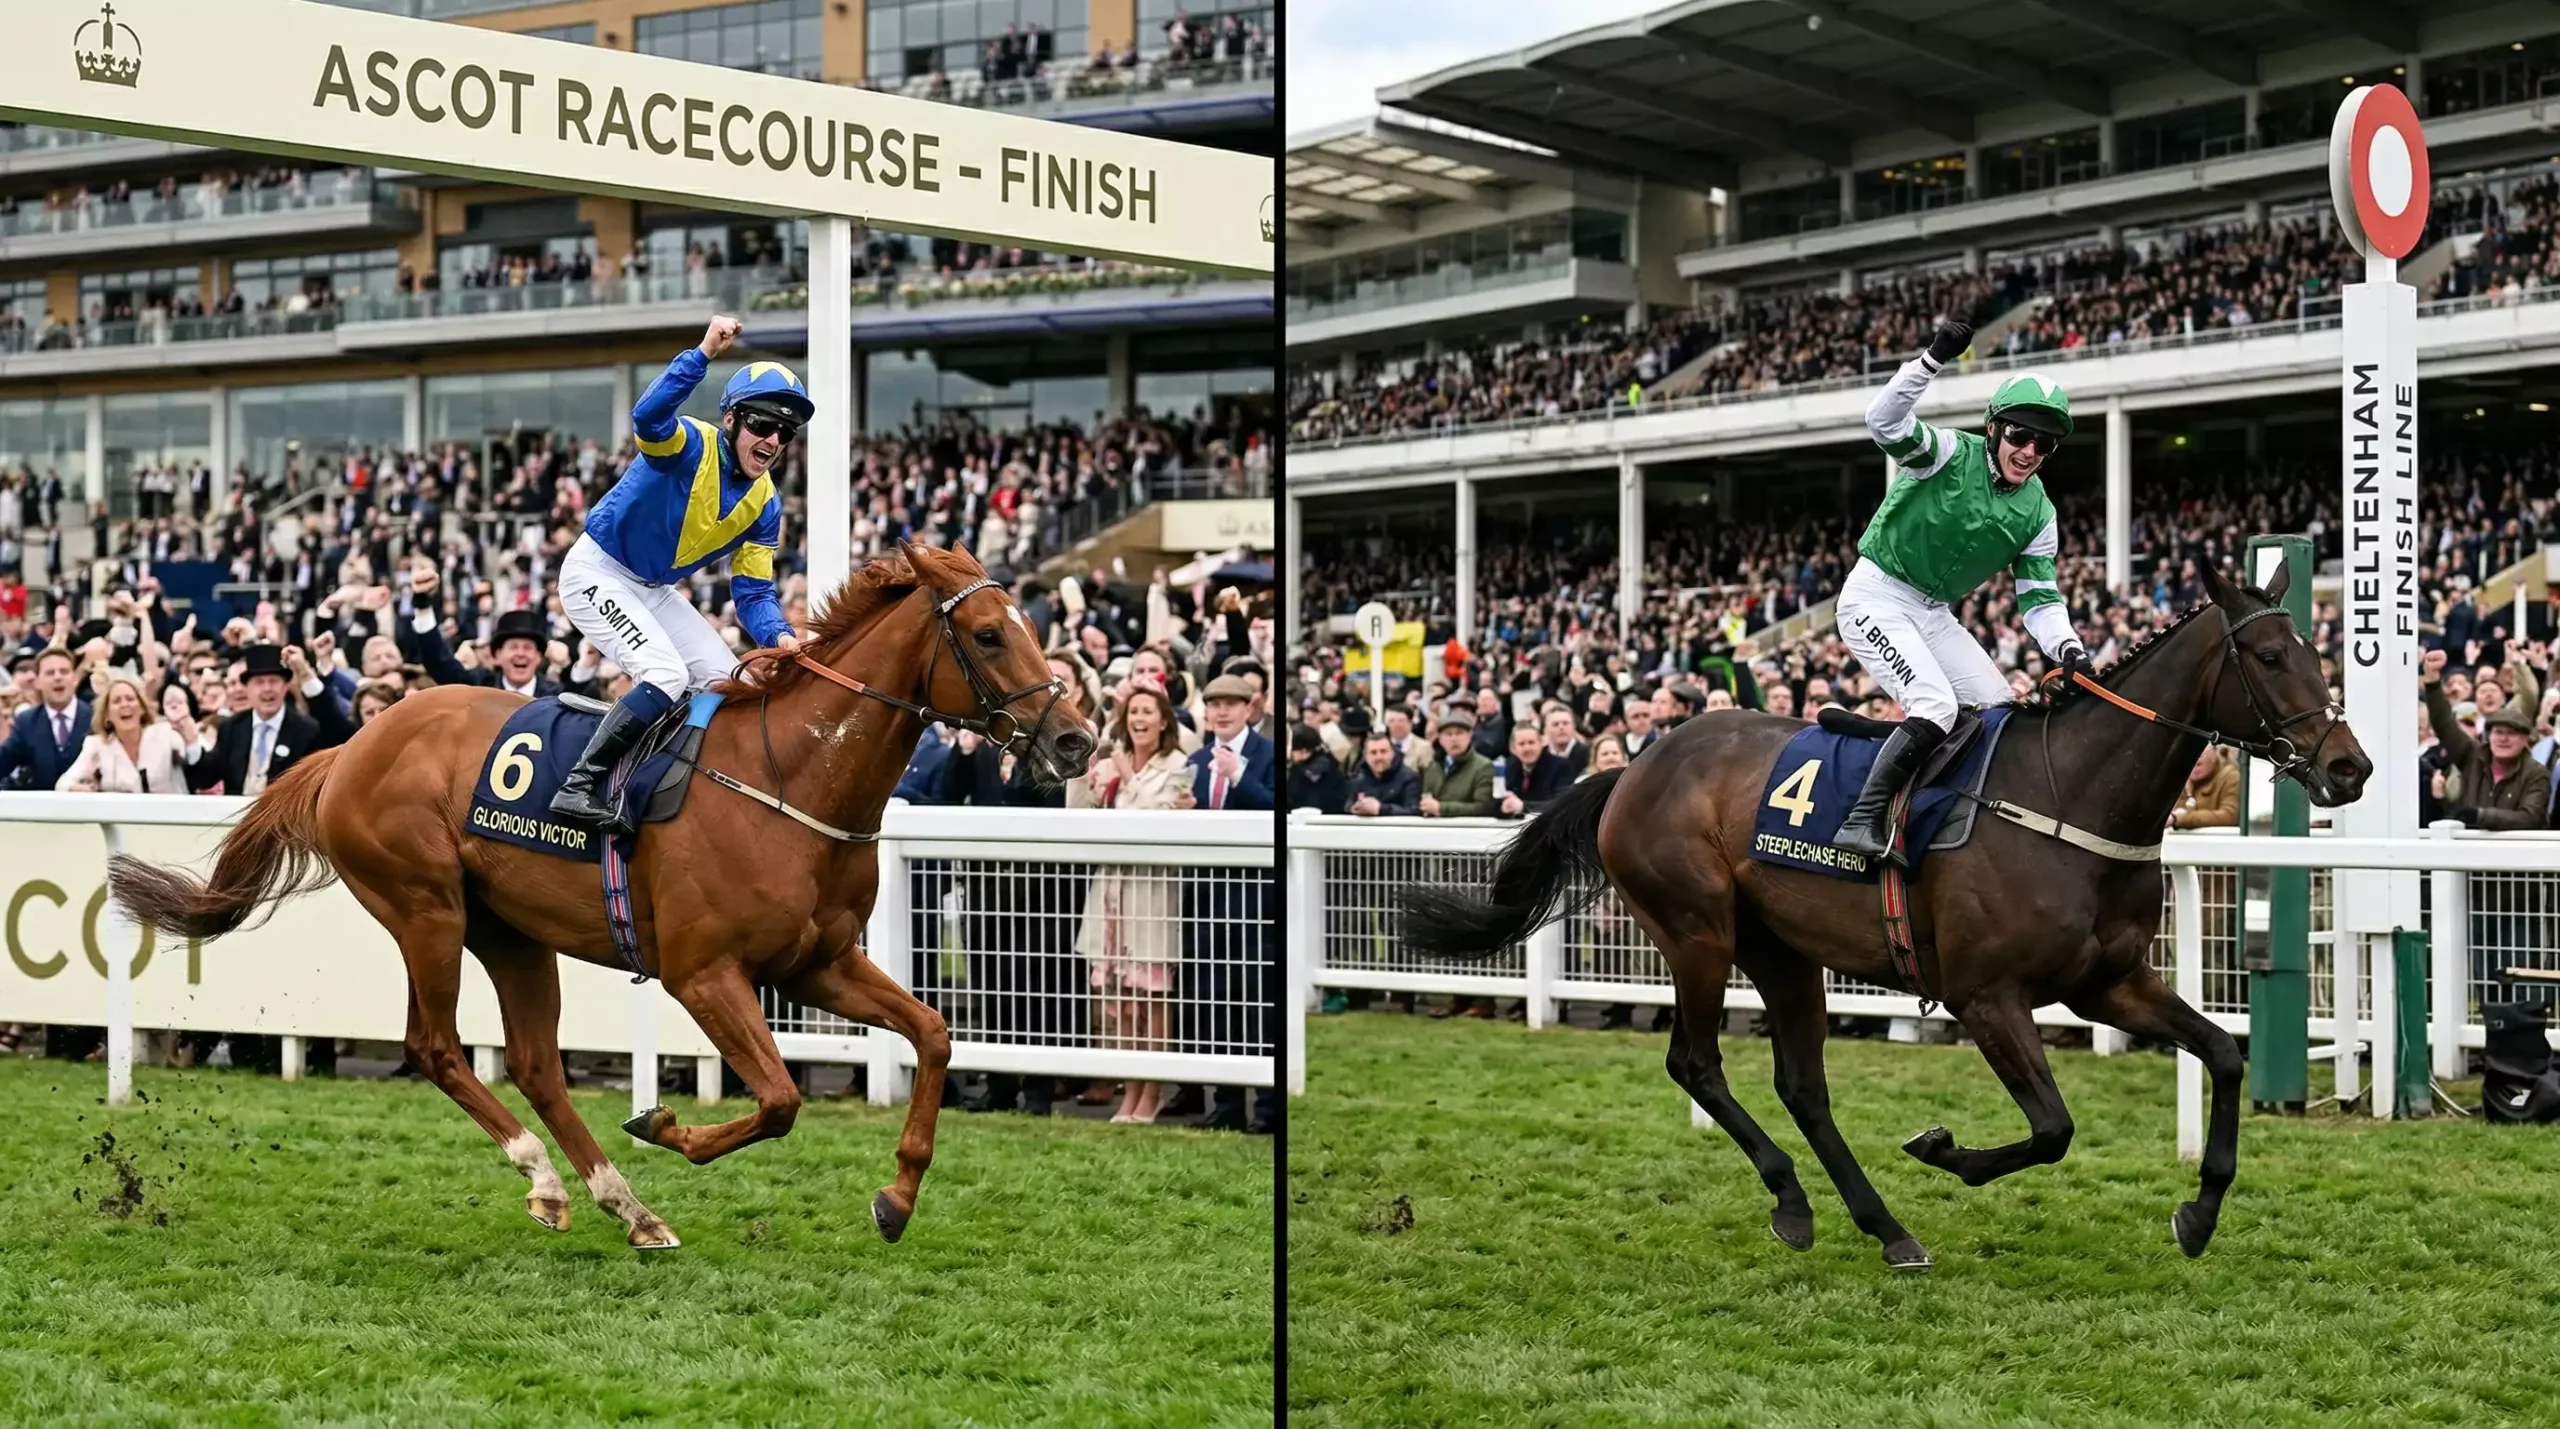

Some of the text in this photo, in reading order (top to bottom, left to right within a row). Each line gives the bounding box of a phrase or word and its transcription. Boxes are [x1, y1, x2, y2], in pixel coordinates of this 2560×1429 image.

[313, 44, 534, 135] ASCOT
[558, 78, 940, 192] RACECOURSE
[1001, 147, 1156, 224] FINISH
[2396, 383, 2412, 479] LINE
[2353, 364, 2380, 667] CHELTENHAM
[2396, 498, 2413, 636] FINISH
[582, 585, 648, 651] A. SMITH
[1855, 615, 1916, 687] J. BROWN
[489, 732, 543, 801] 6
[1768, 759, 1823, 827] 4
[473, 806, 587, 850] GLORIOUS VICTOR
[1755, 833, 1867, 873] STEEPLECHASE HERO
